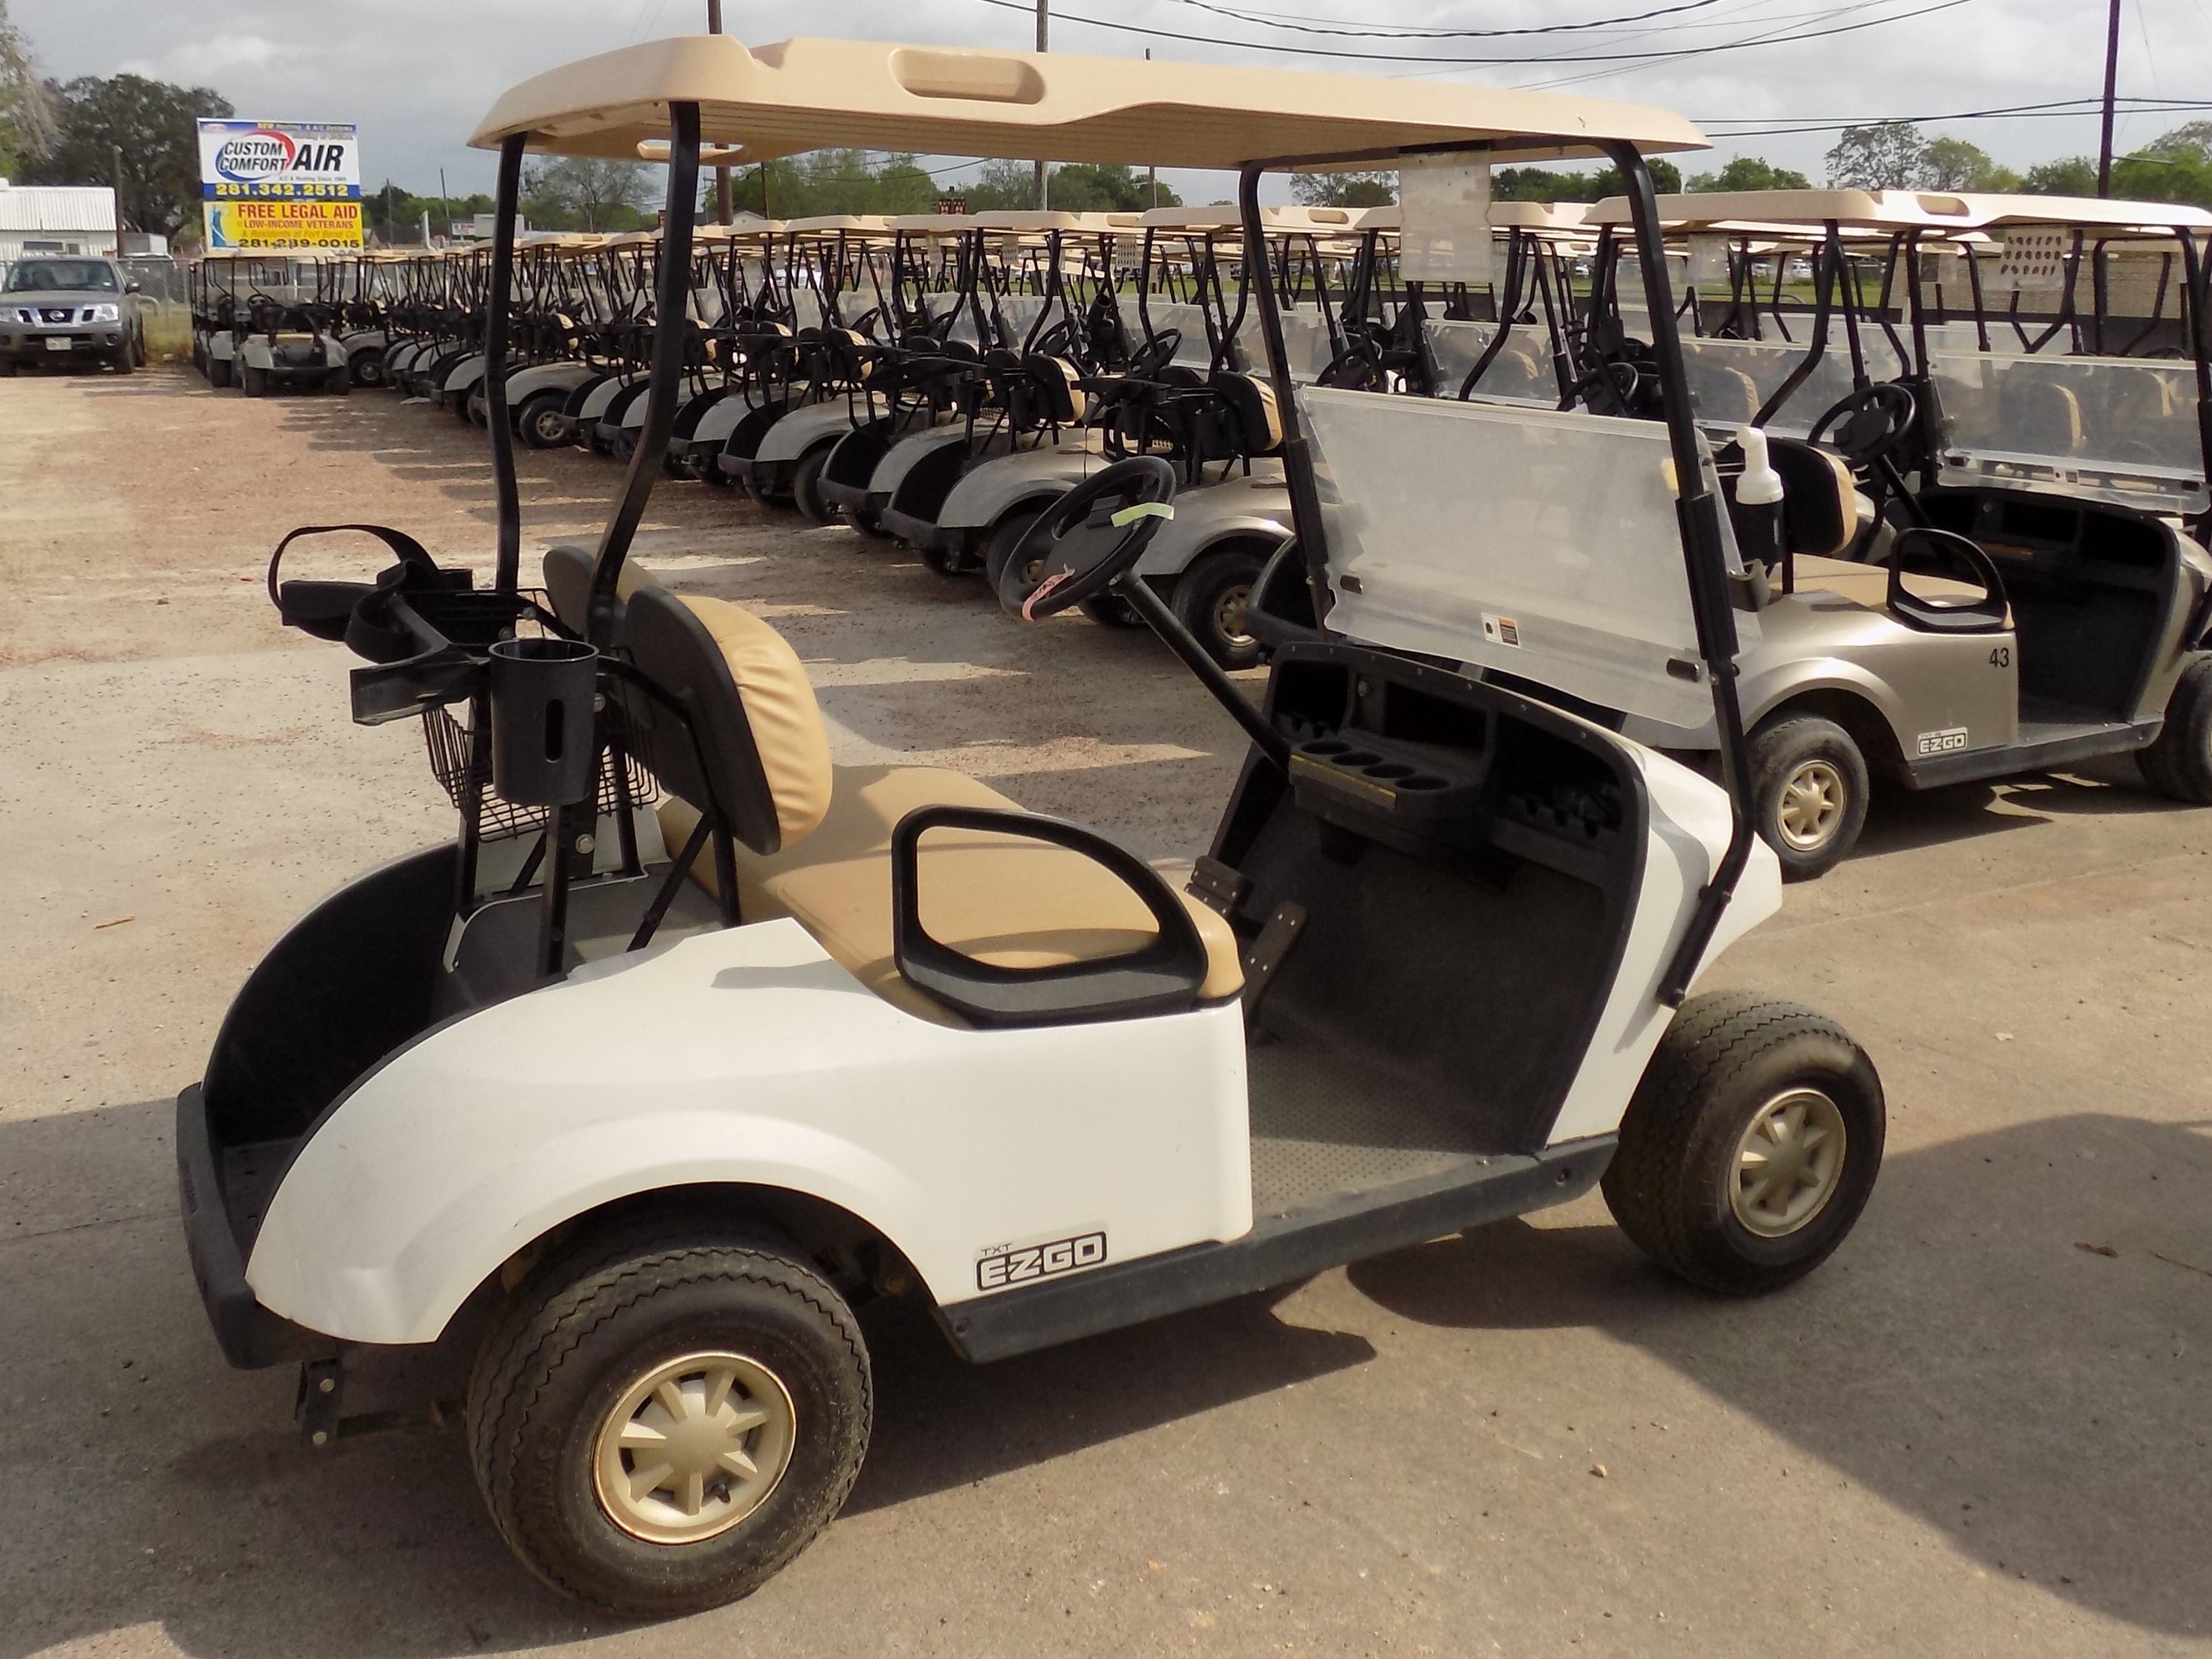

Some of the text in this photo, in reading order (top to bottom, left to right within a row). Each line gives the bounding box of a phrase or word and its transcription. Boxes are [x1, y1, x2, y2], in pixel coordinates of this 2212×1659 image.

[224, 142, 283, 156] CUSTOM
[219, 157, 289, 172] COMFORT
[292, 144, 345, 172] AIR
[216, 182, 348, 197] 281.342.2512
[237, 204, 358, 220] FREE LEGAL AID
[244, 219, 304, 229] LOW-INCOME
[306, 220, 354, 229] VETERANS
[1989, 647, 2010, 668] 43
[981, 1243, 1013, 1256] TXT
